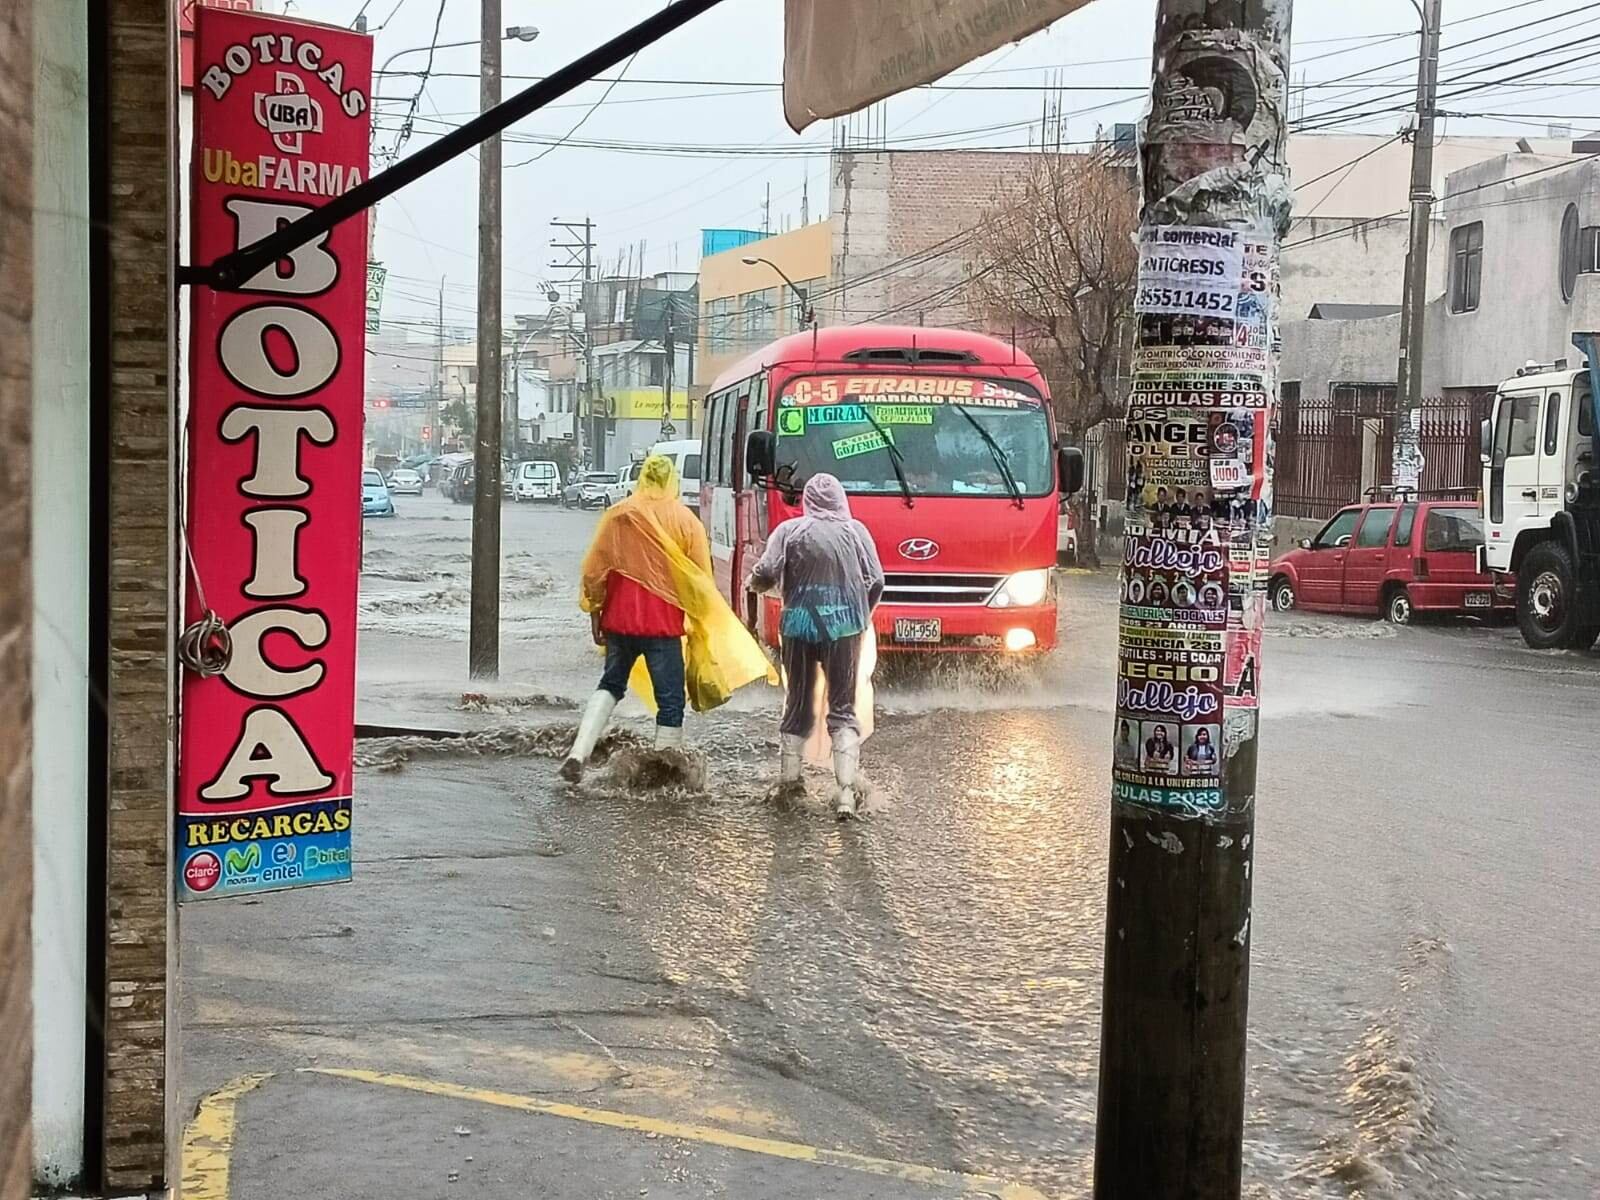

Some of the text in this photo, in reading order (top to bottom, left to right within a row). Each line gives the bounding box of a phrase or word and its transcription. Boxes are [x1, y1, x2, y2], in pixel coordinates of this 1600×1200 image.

[201, 35, 366, 117] BOTICAS
[269, 103, 309, 127] UBA
[203, 148, 362, 197] UbaFARMA
[795, 380, 838, 404] C-5
[844, 379, 973, 397] ETRABUS
[858, 394, 945, 404] MARIANO
[1219, 393, 1265, 406] 2023
[780, 409, 801, 433] C
[1213, 467, 1239, 481] JUDO
[200, 199, 339, 800] BOTICA
[1125, 536, 1223, 578] Vallejo
[1174, 609, 1225, 622] SOCIALES
[1190, 641, 1222, 650] 239
[187, 809, 351, 847] RECARGAS
[186, 866, 214, 879] Claro
[262, 864, 303, 881] entel
